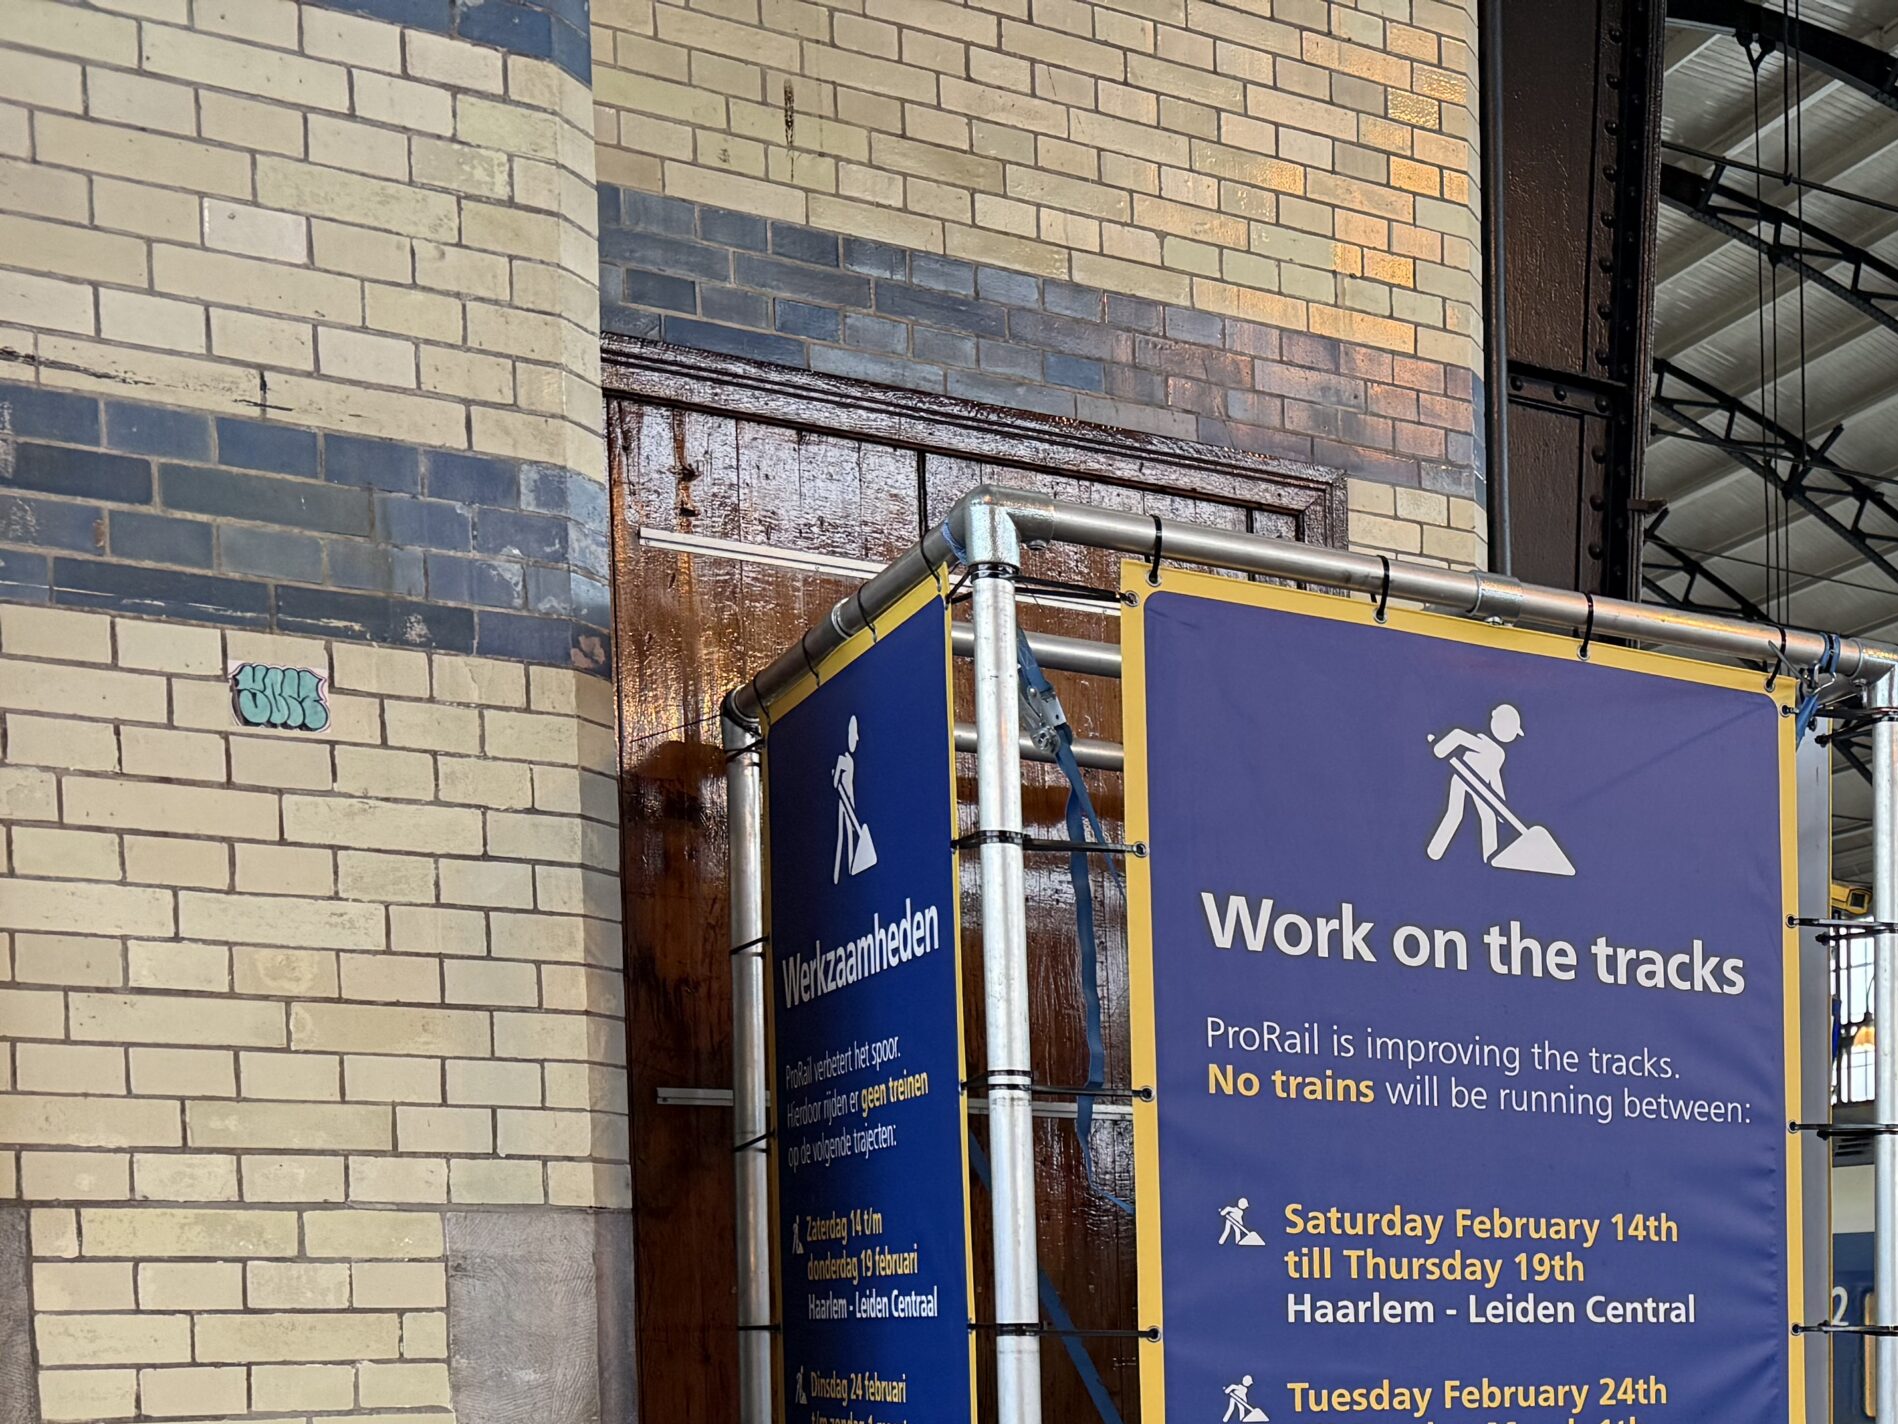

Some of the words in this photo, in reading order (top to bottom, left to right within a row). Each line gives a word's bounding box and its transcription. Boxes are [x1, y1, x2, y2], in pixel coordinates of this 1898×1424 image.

[782, 898, 939, 1009] Werkzaamheden
[1200, 891, 1378, 963] Work
[1392, 925, 1468, 971] on
[1483, 920, 1578, 981] the
[1590, 936, 1745, 995] tracks
[854, 1040, 870, 1069] het
[871, 1036, 901, 1071] spoor.
[1207, 1016, 1319, 1055] ProRail
[1332, 1024, 1355, 1058] is
[1367, 1027, 1520, 1076] improving
[1530, 1040, 1579, 1073] the
[1588, 1047, 1680, 1079] tracks.
[850, 1090, 859, 1112] er
[861, 1083, 887, 1117] geen
[888, 1069, 929, 1103] treinen
[1208, 1063, 1260, 1097] No
[1271, 1069, 1375, 1103] trains
[1385, 1074, 1438, 1107] will
[1451, 1076, 1488, 1110] be
[1499, 1088, 1613, 1124] running
[1624, 1087, 1750, 1124] between:
[854, 1123, 897, 1159] trajecten:
[806, 1211, 847, 1245] Zaterdag
[850, 1209, 862, 1236] 14
[863, 1207, 883, 1235] t/m
[1284, 1203, 1445, 1245] Saturday
[1455, 1207, 1601, 1248] February
[1610, 1212, 1678, 1242] 14th
[807, 1251, 858, 1285] donderdag
[861, 1249, 873, 1277] 19
[875, 1243, 918, 1276] februari
[1283, 1246, 1332, 1279] till
[1342, 1247, 1503, 1289] Thursday
[1514, 1251, 1585, 1282] 19th
[808, 1290, 847, 1319] Haarlem
[855, 1289, 889, 1318] Leiden
[891, 1285, 938, 1318] Centraal
[1287, 1291, 1434, 1324] Haarlem
[1469, 1292, 1575, 1324] Leiden
[1586, 1293, 1695, 1324] Central
[1832, 1286, 1849, 1327] 2
[810, 1371, 848, 1407] Dinsdag
[850, 1373, 863, 1400] 24
[864, 1371, 906, 1403] februari
[1286, 1378, 1433, 1418] Tuesday
[1444, 1377, 1590, 1414] February
[1599, 1375, 1667, 1406] 24th
